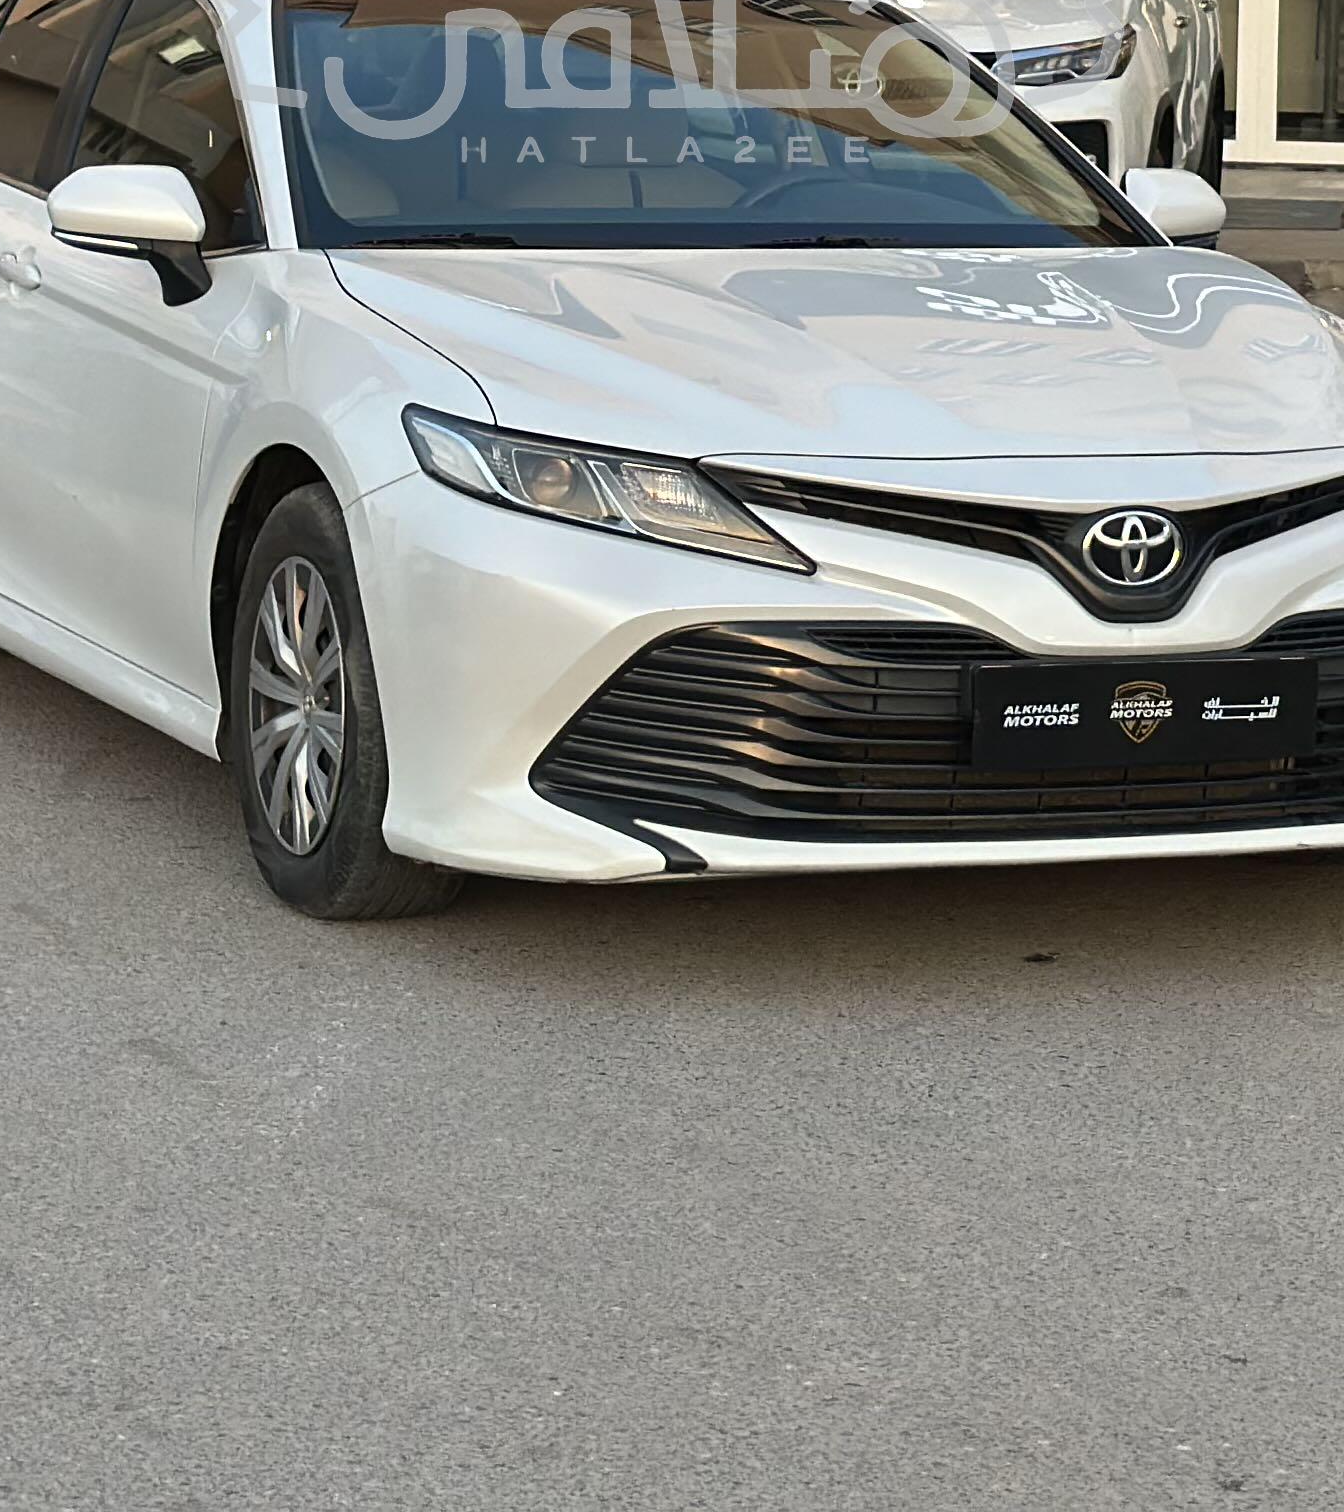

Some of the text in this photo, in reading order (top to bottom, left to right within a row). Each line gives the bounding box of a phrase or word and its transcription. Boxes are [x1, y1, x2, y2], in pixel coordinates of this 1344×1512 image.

[1003, 702, 1080, 715] ALKHALAF
[1110, 699, 1174, 709] ALKHALAF
[1109, 708, 1174, 719] MOTORS
[1002, 714, 1080, 728] MOTORS
